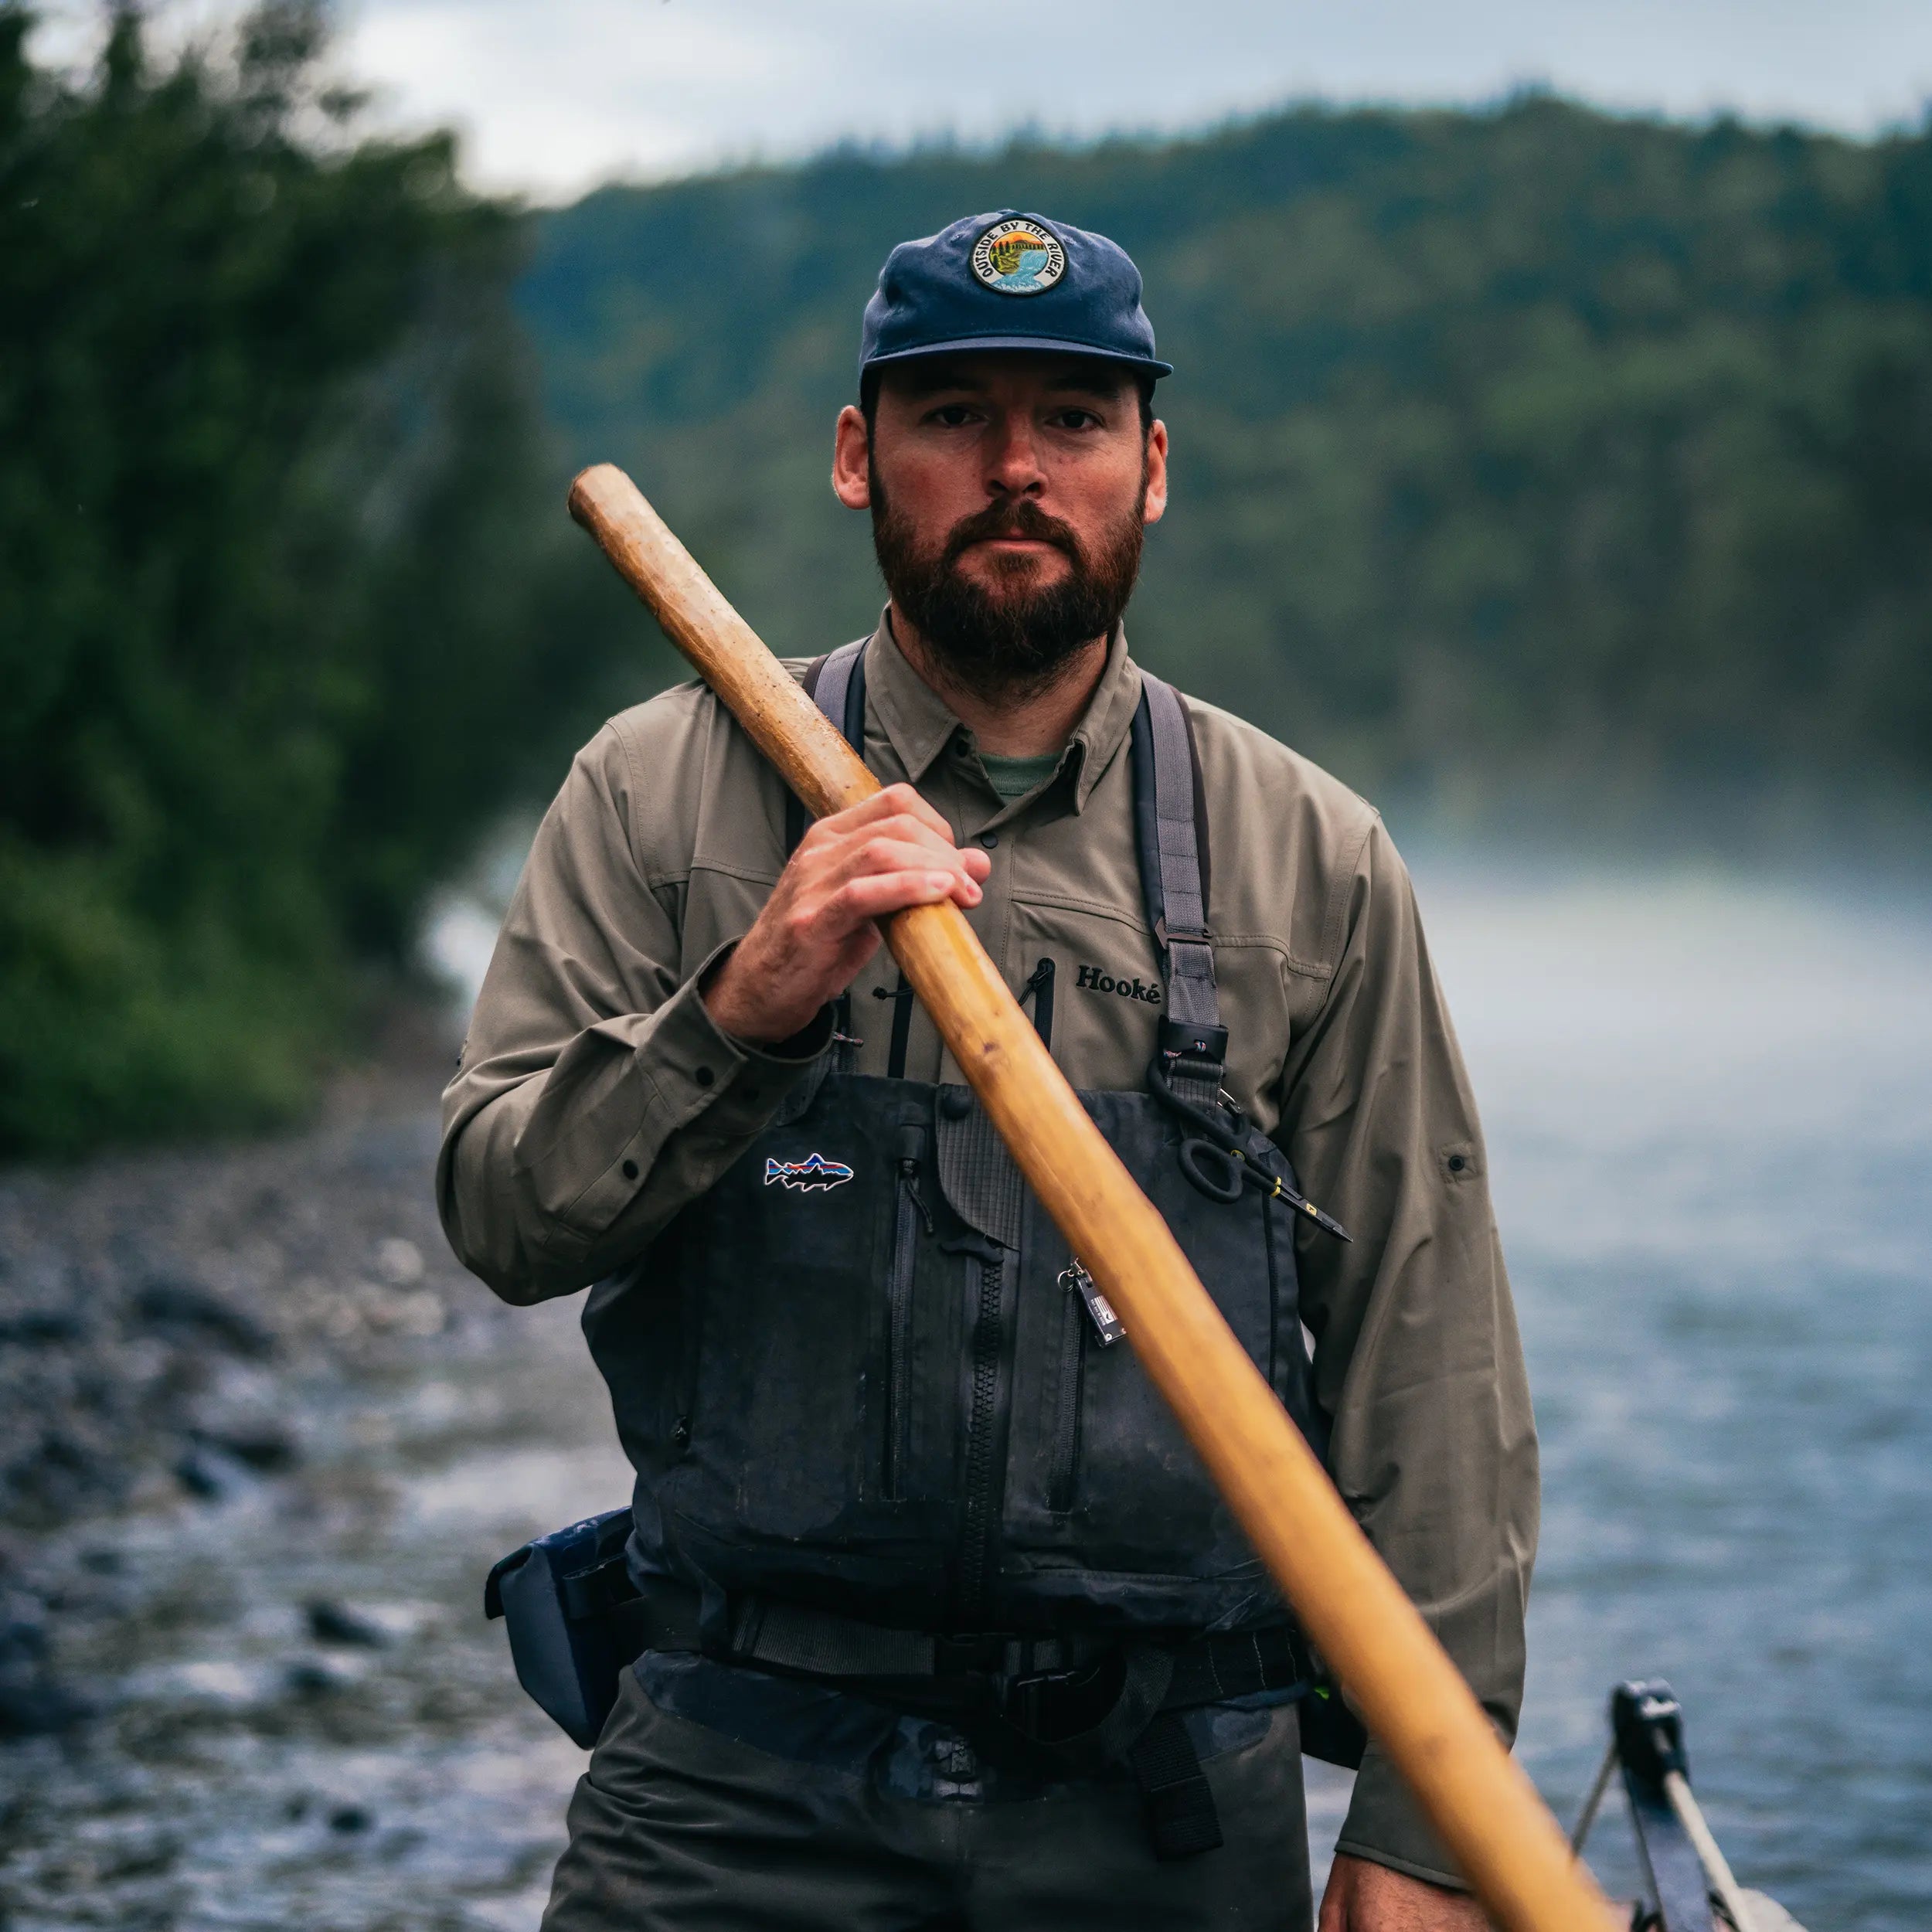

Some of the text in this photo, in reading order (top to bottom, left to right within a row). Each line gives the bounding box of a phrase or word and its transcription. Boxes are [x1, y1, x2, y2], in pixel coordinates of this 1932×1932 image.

[975, 222, 1062, 278] OUTSIDE BY THE RIVER
[1076, 964, 1161, 1005] Hooké
